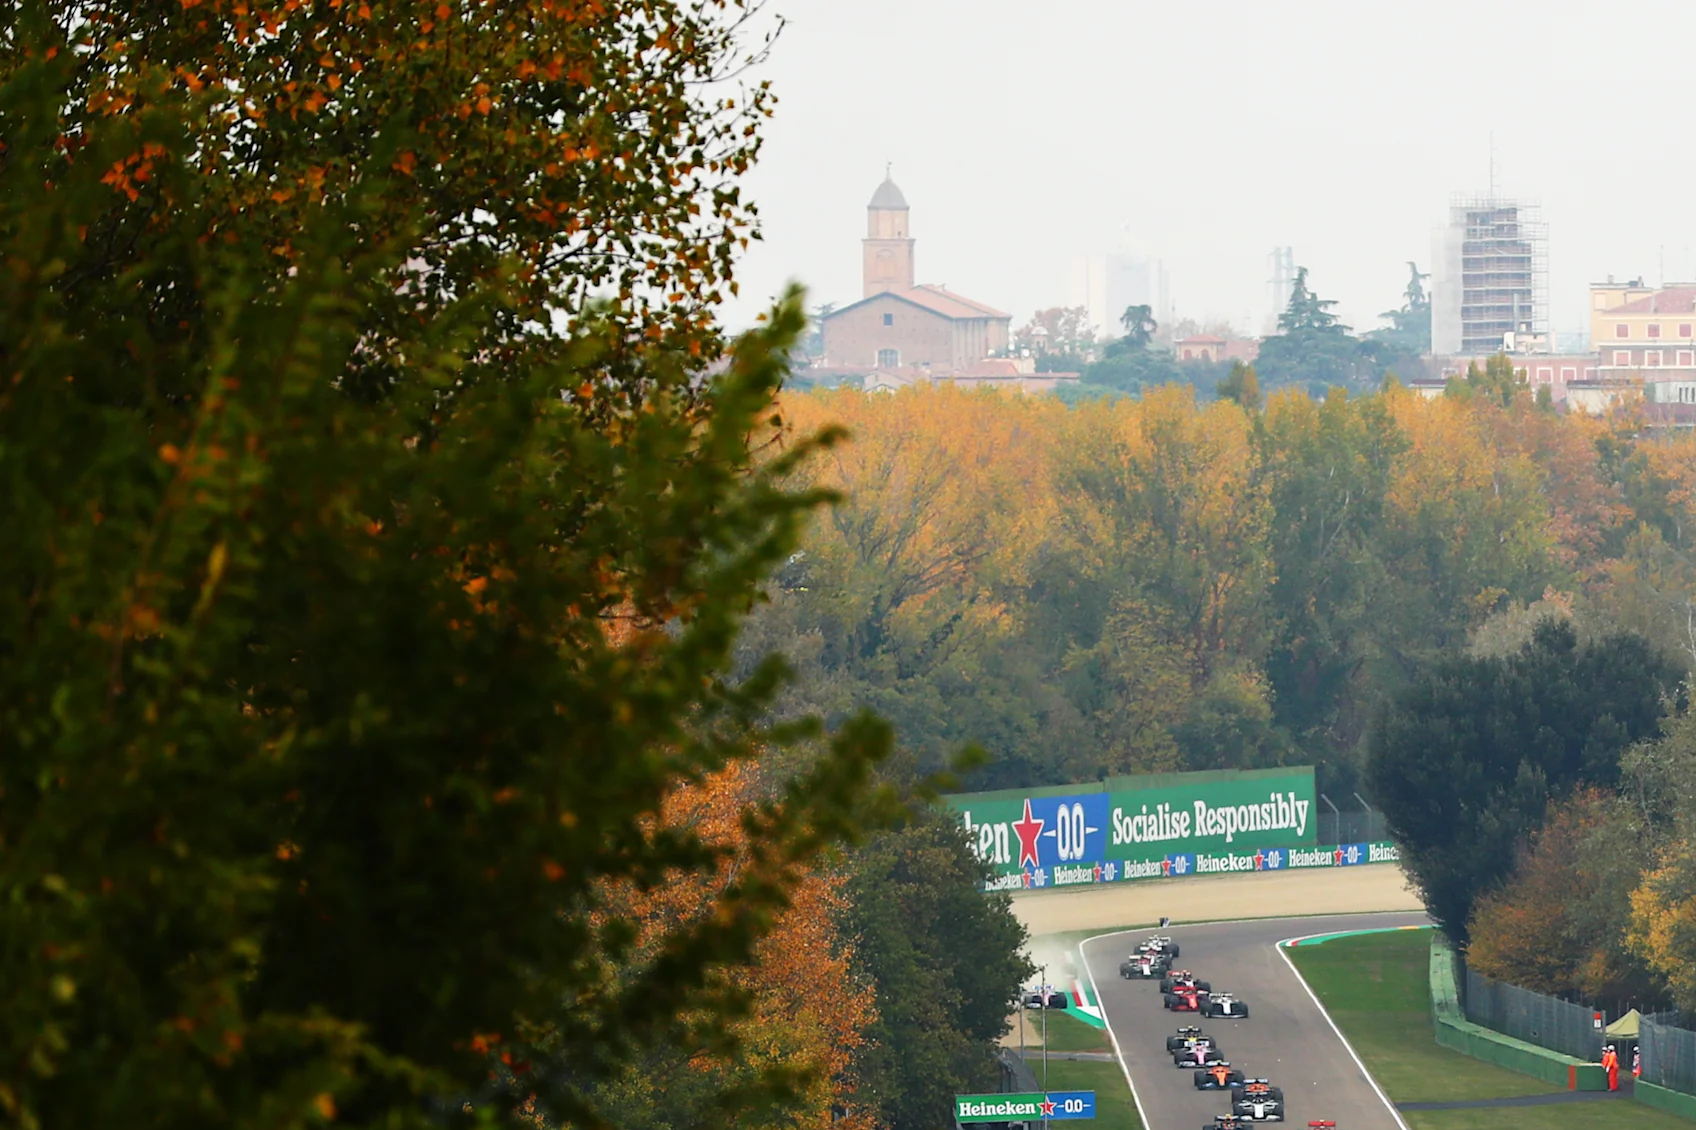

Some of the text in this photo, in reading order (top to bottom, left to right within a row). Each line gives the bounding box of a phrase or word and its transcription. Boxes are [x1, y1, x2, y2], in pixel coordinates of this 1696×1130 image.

[1112, 792, 1309, 845] Socialise Responsibly
[1196, 853, 1253, 872] Heineken
[1289, 848, 1332, 867] Heineken
[1054, 865, 1092, 884] Heineken
[1124, 859, 1161, 878] Heineken
[959, 1101, 1036, 1116] Heineken
